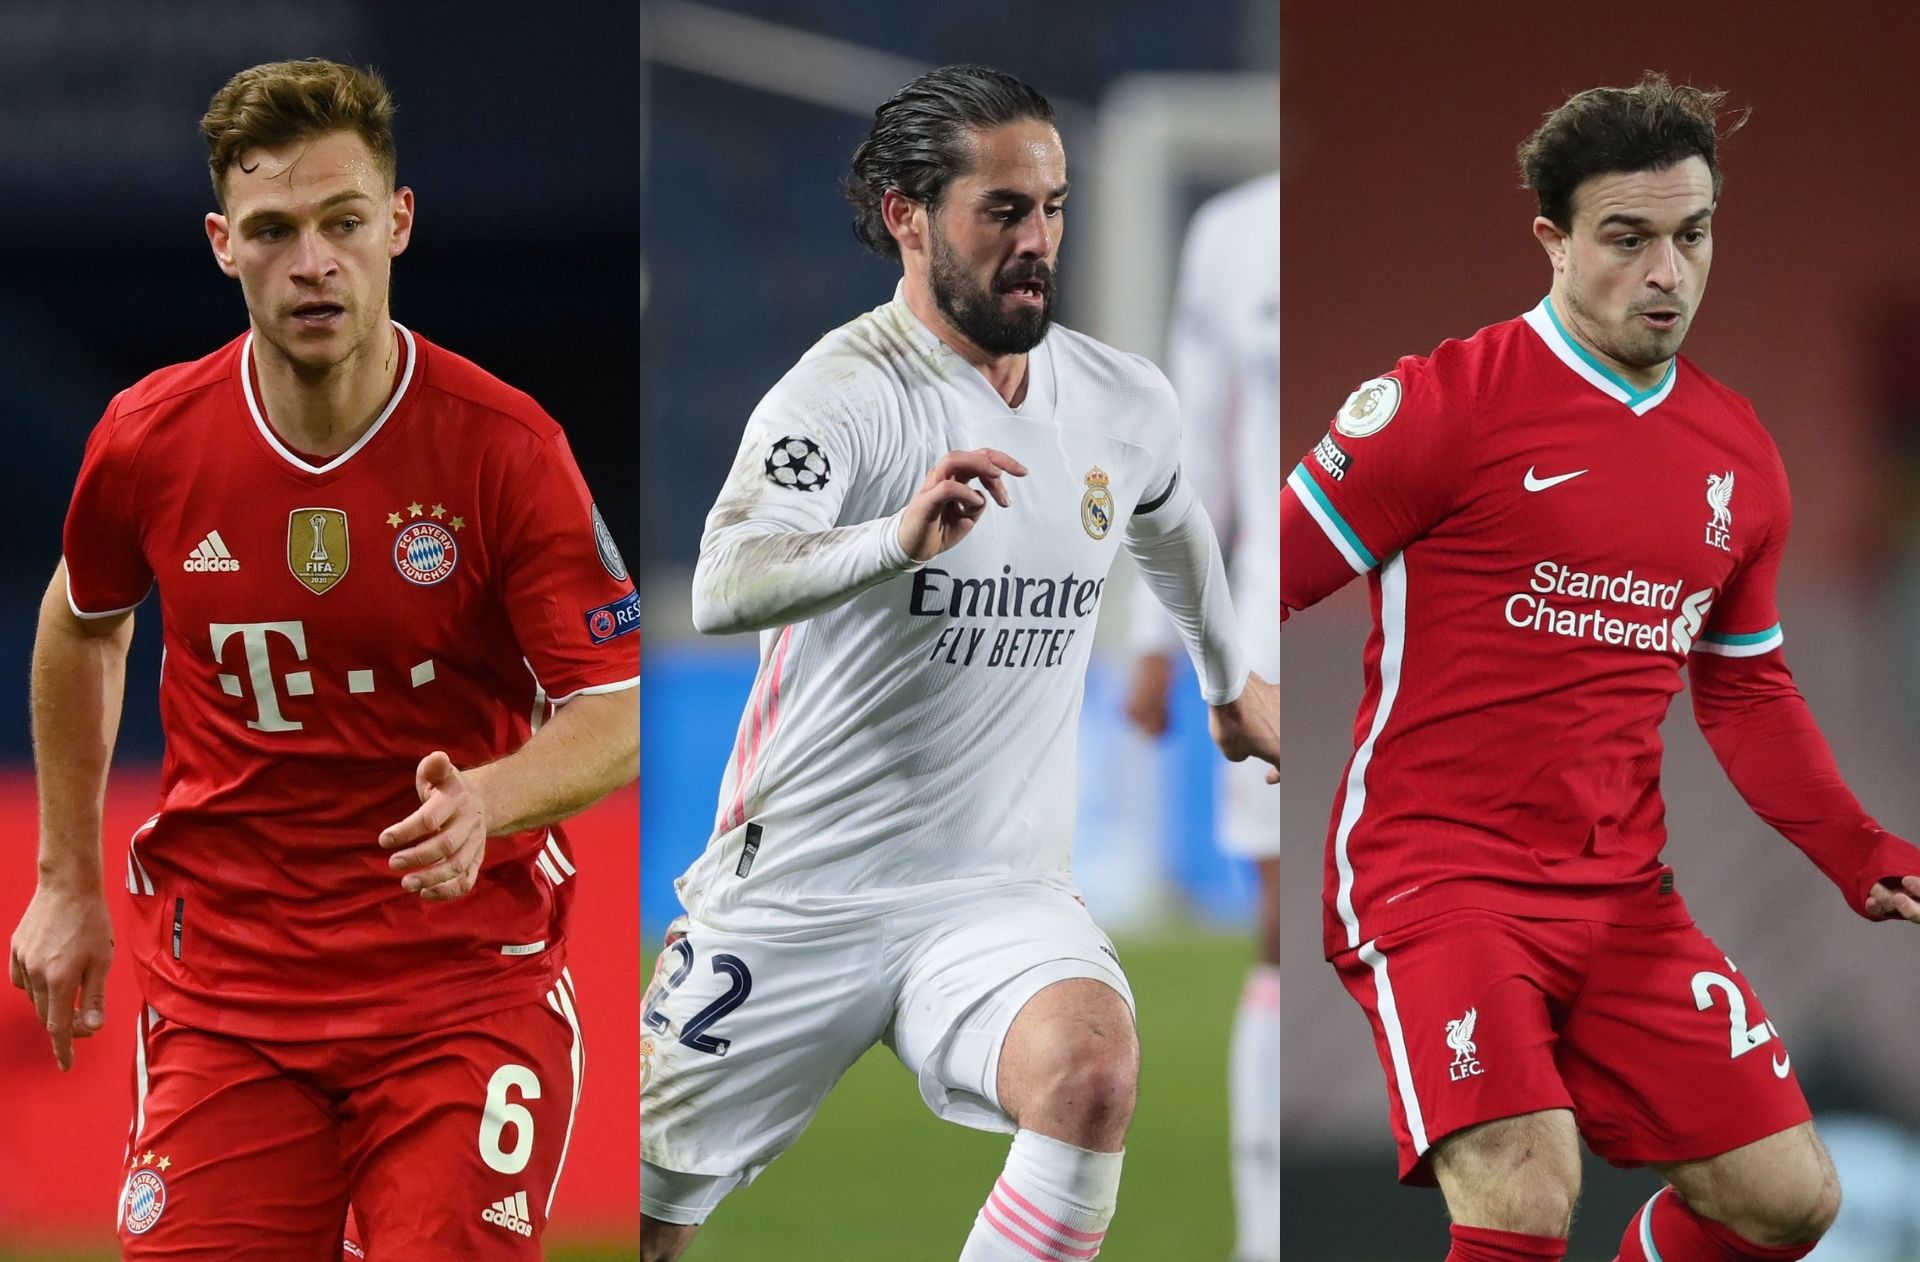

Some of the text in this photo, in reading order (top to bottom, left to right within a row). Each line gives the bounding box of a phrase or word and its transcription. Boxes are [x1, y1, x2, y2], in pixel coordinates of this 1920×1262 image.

[399, 526, 453, 550] FC BAYERN
[1705, 527, 1731, 552] L.F.C.
[183, 557, 240, 572] adidas
[306, 562, 332, 573] FIFA
[399, 559, 452, 581] MÜNCHEN
[1530, 561, 1682, 610] Standard
[617, 601, 640, 625] RES
[1505, 593, 1667, 652] Chartered
[929, 627, 987, 666] FLY
[643, 938, 752, 1058] 22
[1691, 955, 1779, 1059] 2
[1449, 1061, 1485, 1081] L.F.C.
[479, 1064, 541, 1175] 6
[133, 1174, 161, 1193] BAYERN
[482, 1208, 532, 1238] adidas
